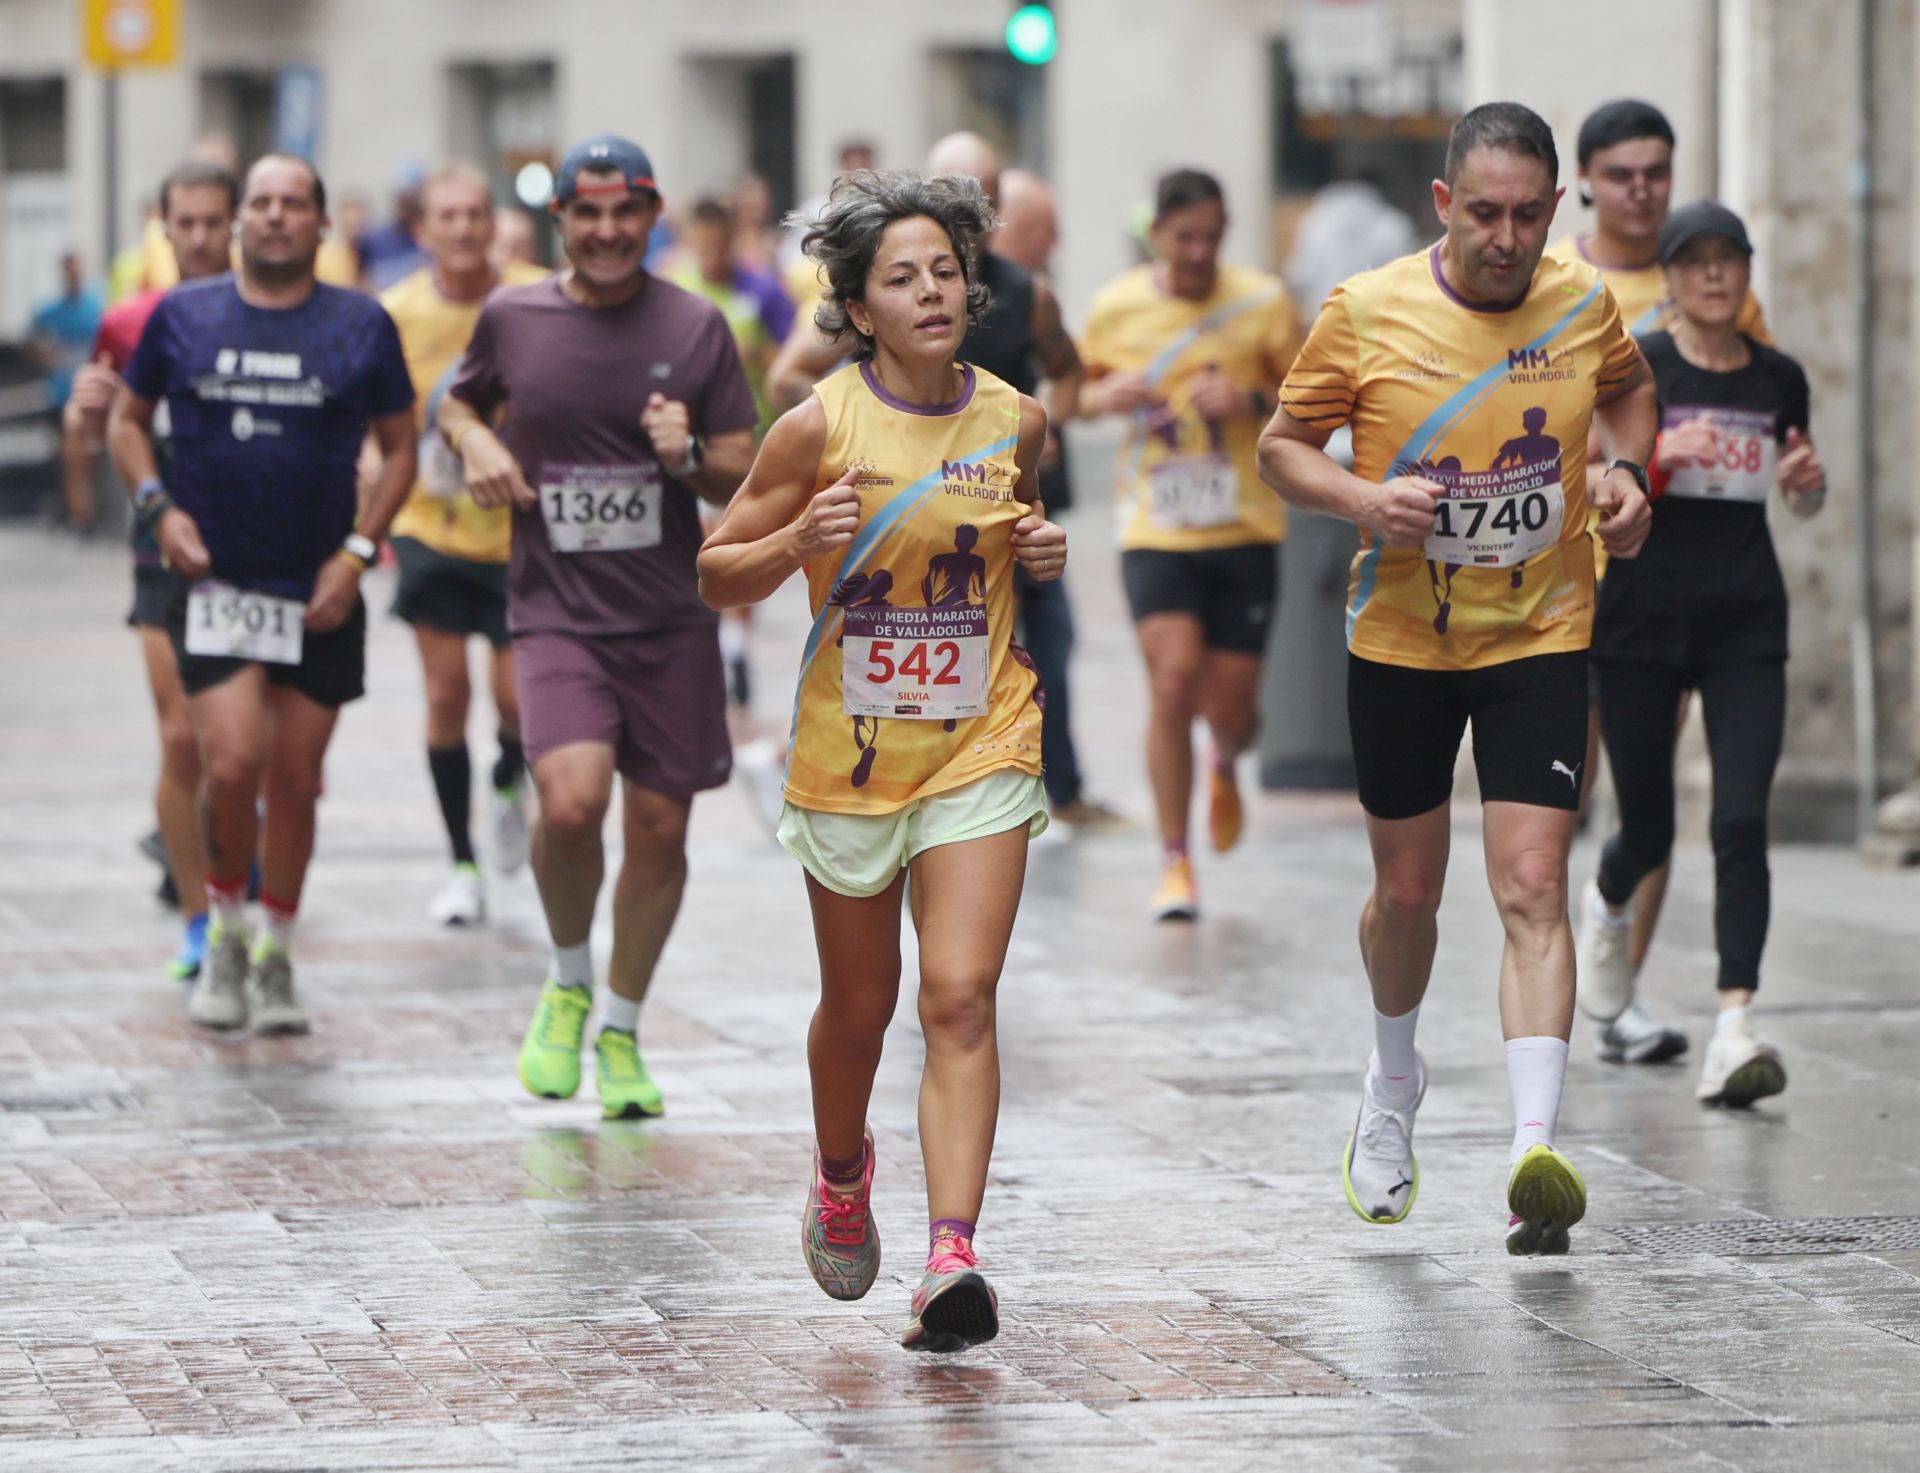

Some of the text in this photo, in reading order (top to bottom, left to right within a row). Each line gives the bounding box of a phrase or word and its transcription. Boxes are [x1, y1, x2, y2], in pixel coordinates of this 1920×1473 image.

[1510, 368, 1577, 385] VALLADOLID
[1459, 473, 1500, 487] MEDIA
[1503, 458, 1557, 481] MARATÓN
[944, 484, 1014, 503] VALLADOLID
[1450, 476, 1544, 498] DE VALLADOLID
[550, 490, 646, 523] 1366
[1434, 492, 1549, 539] 1740
[1466, 542, 1515, 552] VICENTERP
[202, 600, 287, 637] 1901
[885, 612, 929, 623] MEDIA
[932, 607, 986, 621] MARATÓN
[875, 624, 973, 637] DE VALLADOLID
[866, 640, 961, 685] 542
[897, 692, 930, 701] SILVIA
